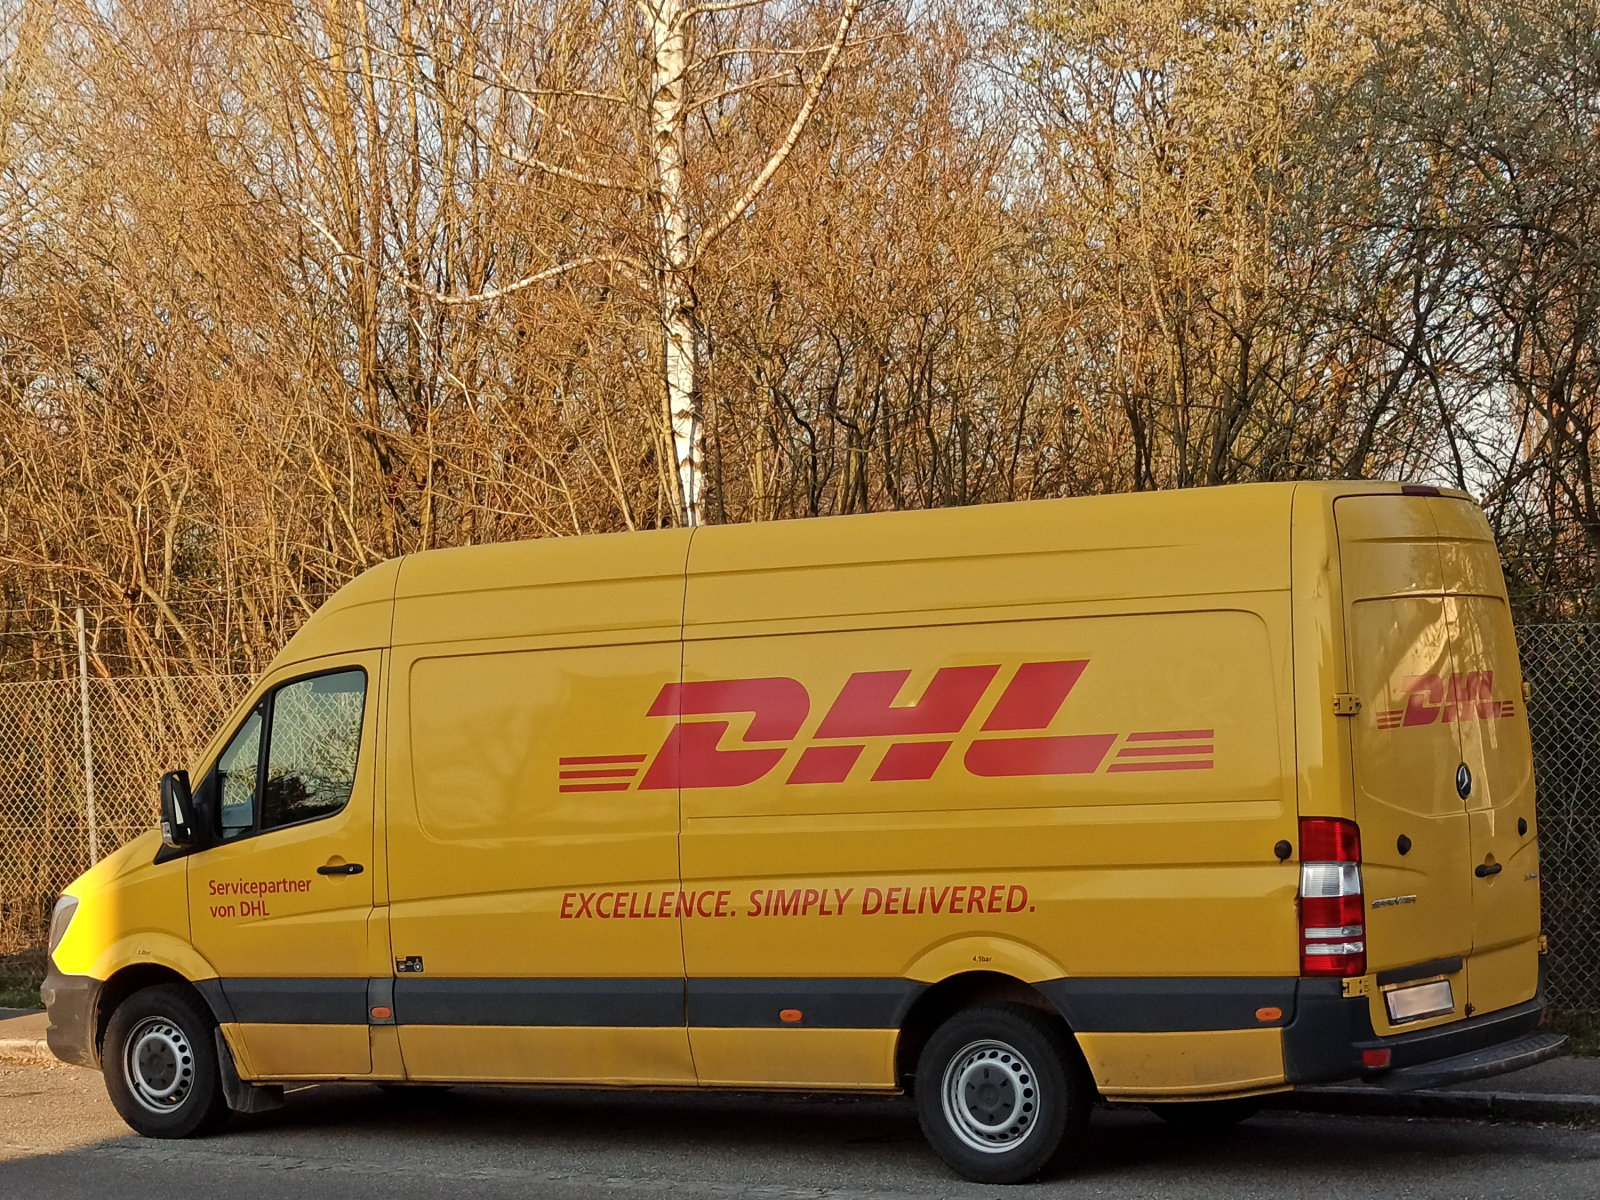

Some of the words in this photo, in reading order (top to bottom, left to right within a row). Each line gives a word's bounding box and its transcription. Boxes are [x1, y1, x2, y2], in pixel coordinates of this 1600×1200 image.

[1401, 670, 1502, 728] DHL
[637, 659, 1119, 791] DHL
[208, 878, 312, 898] Servicepartner
[560, 890, 737, 920] EXCELLENCE.
[747, 888, 853, 917] SIMPLY
[861, 884, 1037, 915] DELIVERED.
[210, 904, 235, 918] von
[240, 900, 270, 917] DHL
